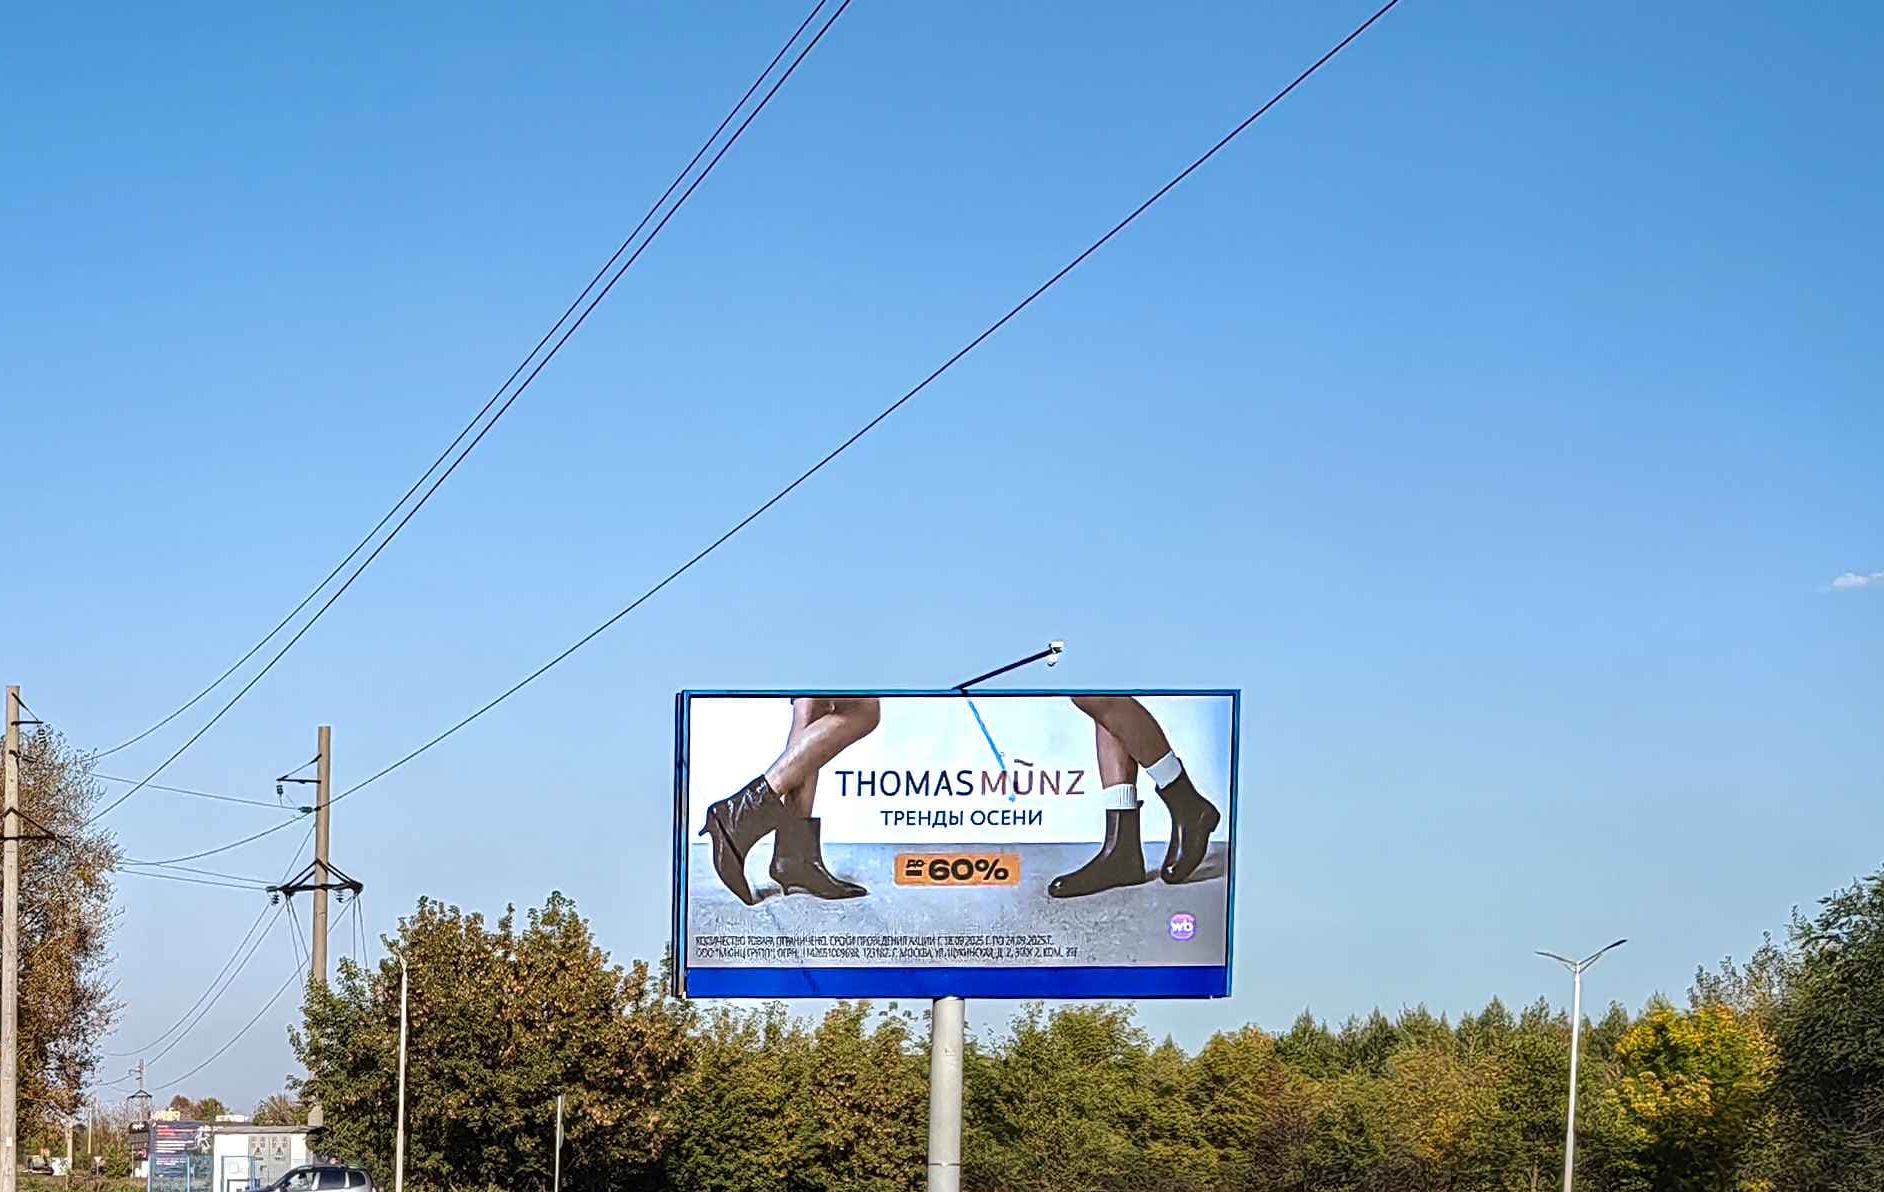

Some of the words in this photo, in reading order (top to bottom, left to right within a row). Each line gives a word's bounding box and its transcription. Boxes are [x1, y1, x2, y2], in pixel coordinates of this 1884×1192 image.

[835, 770, 974, 797] THOMAS
[880, 810, 964, 828] ТРЕНДЫ
[970, 809, 1044, 826] ОСЕНИ
